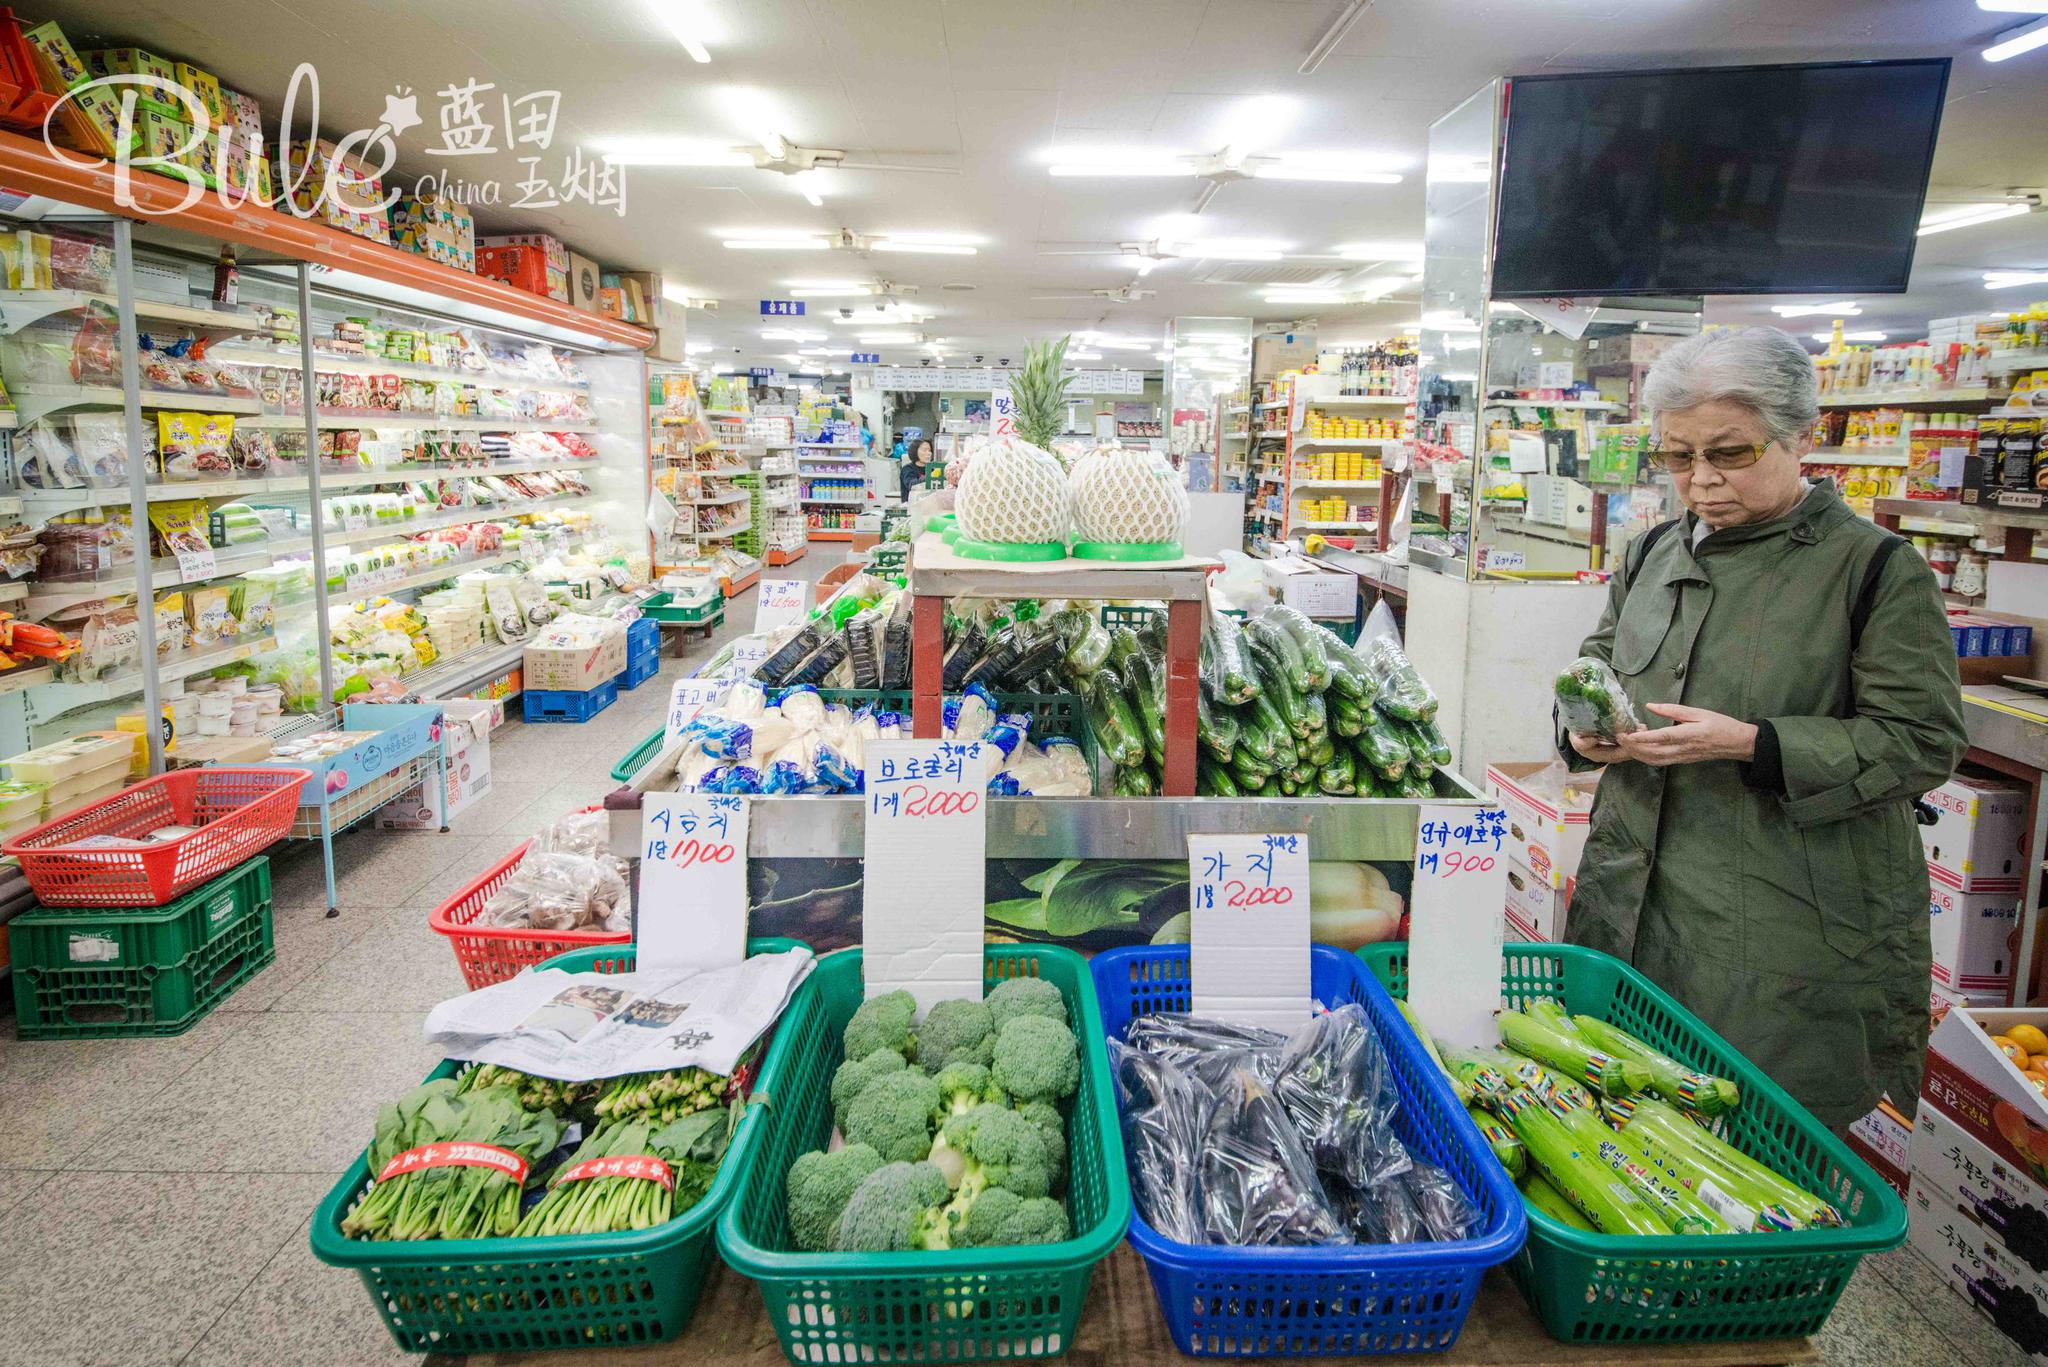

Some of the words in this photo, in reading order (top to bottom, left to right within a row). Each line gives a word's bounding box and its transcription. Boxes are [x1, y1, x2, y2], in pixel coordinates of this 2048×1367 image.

[938, 741, 981, 759] 국내산
[874, 792, 899, 817] 1개
[1475, 809, 1507, 825] 국내산
[1263, 834, 1298, 854] 국내산
[1441, 851, 1495, 878] 900
[1197, 884, 1214, 909] 1봉
